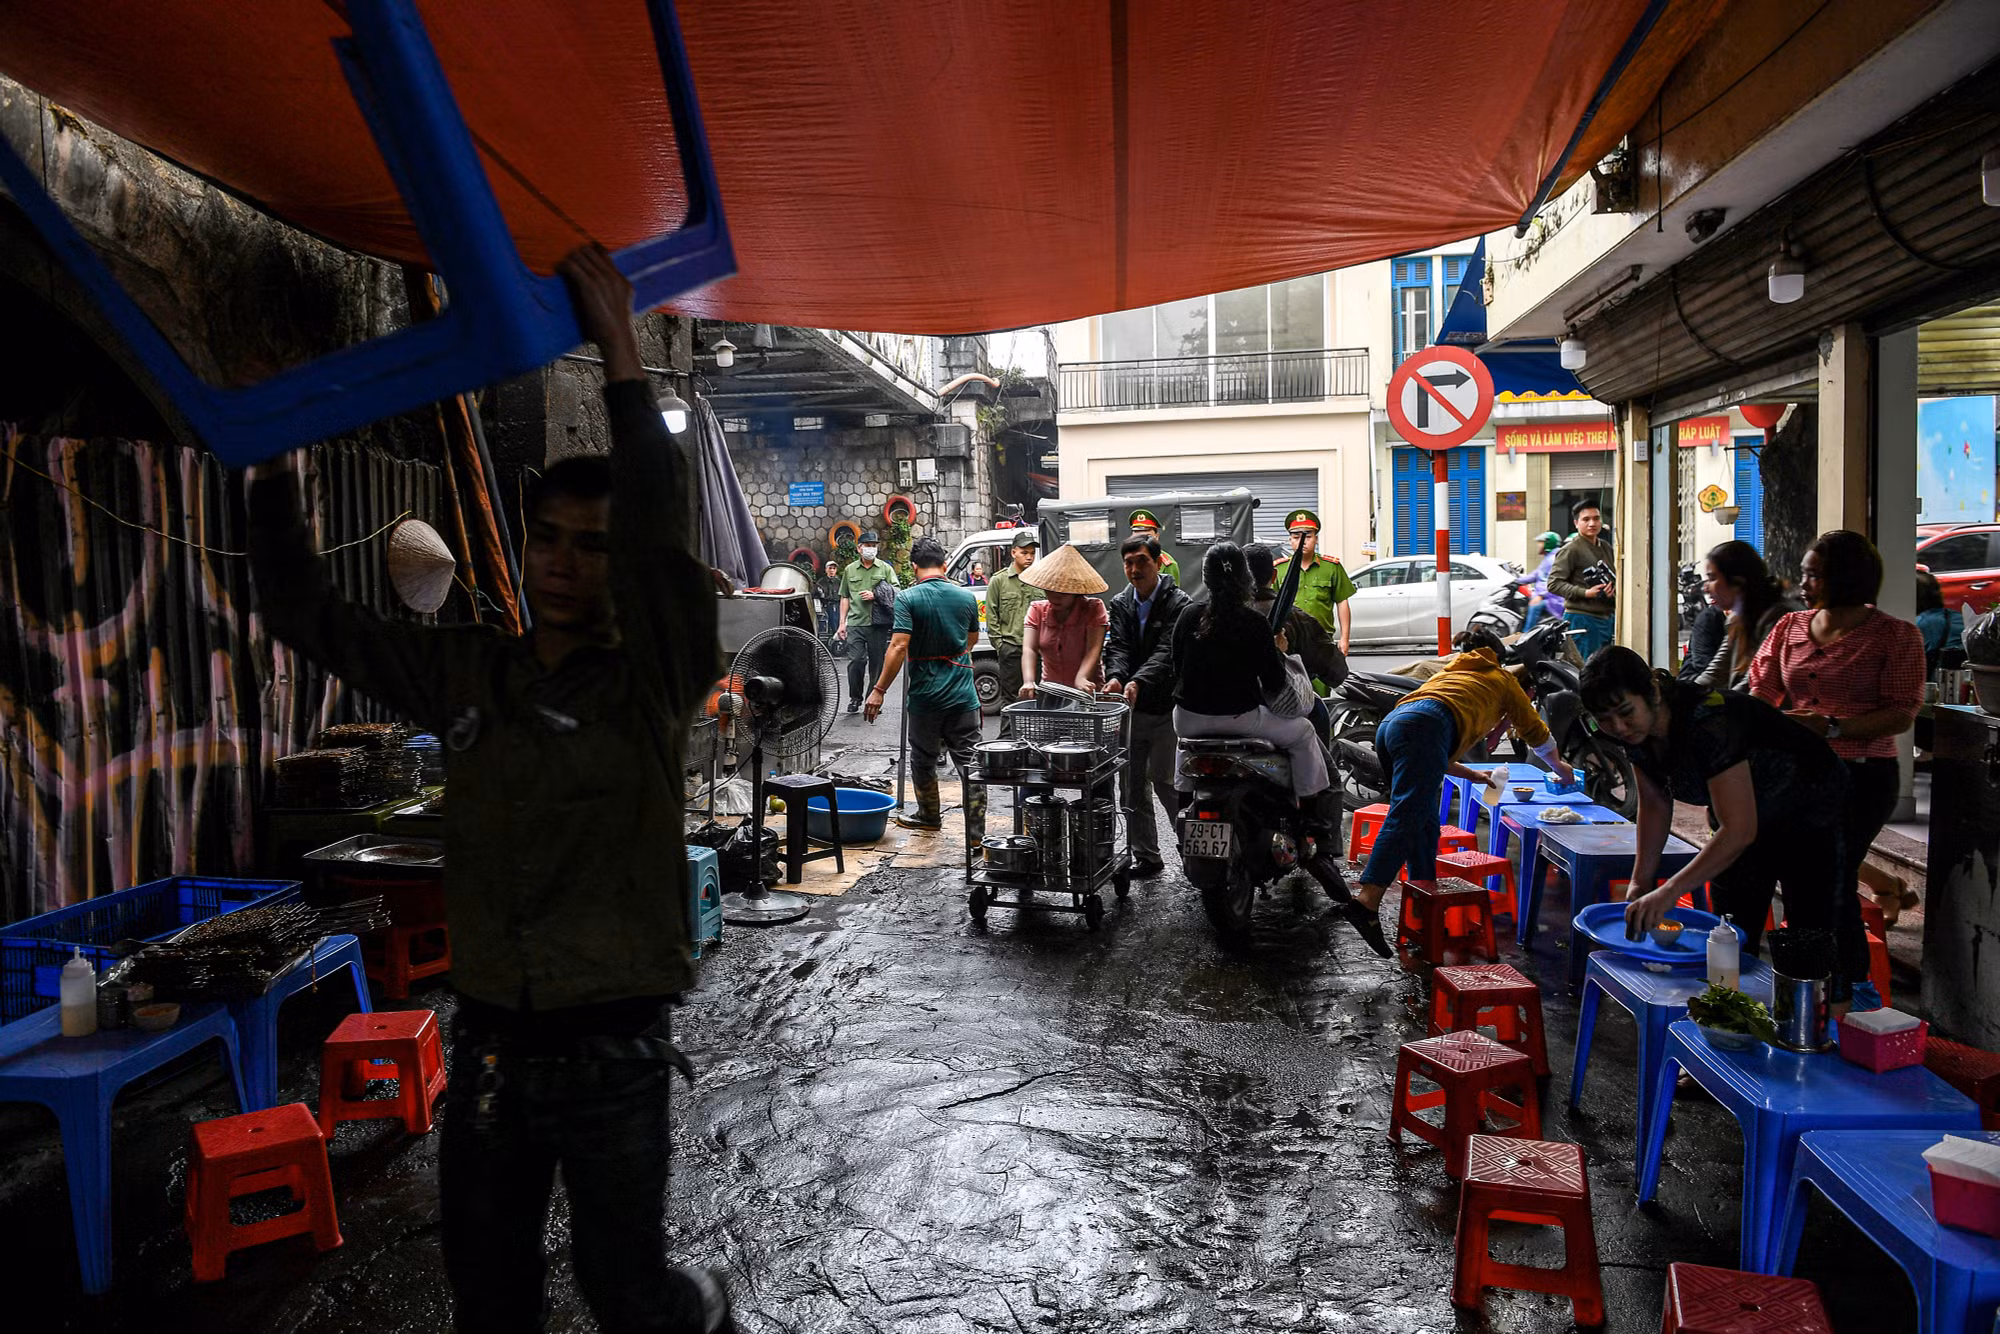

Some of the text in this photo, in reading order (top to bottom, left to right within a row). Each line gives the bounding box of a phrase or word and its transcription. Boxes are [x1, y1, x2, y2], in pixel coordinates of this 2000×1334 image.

[1504, 429, 1528, 448] SỐNG
[1530, 429, 1542, 447] VÀ
[1543, 429, 1562, 446] LÀM
[1564, 429, 1584, 448] VIỆC
[1586, 431, 1608, 445] THEO
[1679, 424, 1696, 440] HÁP
[1699, 423, 1721, 440] LUẬT
[1190, 823, 1225, 840] 29-C1
[1185, 840, 1228, 857] 563.67
